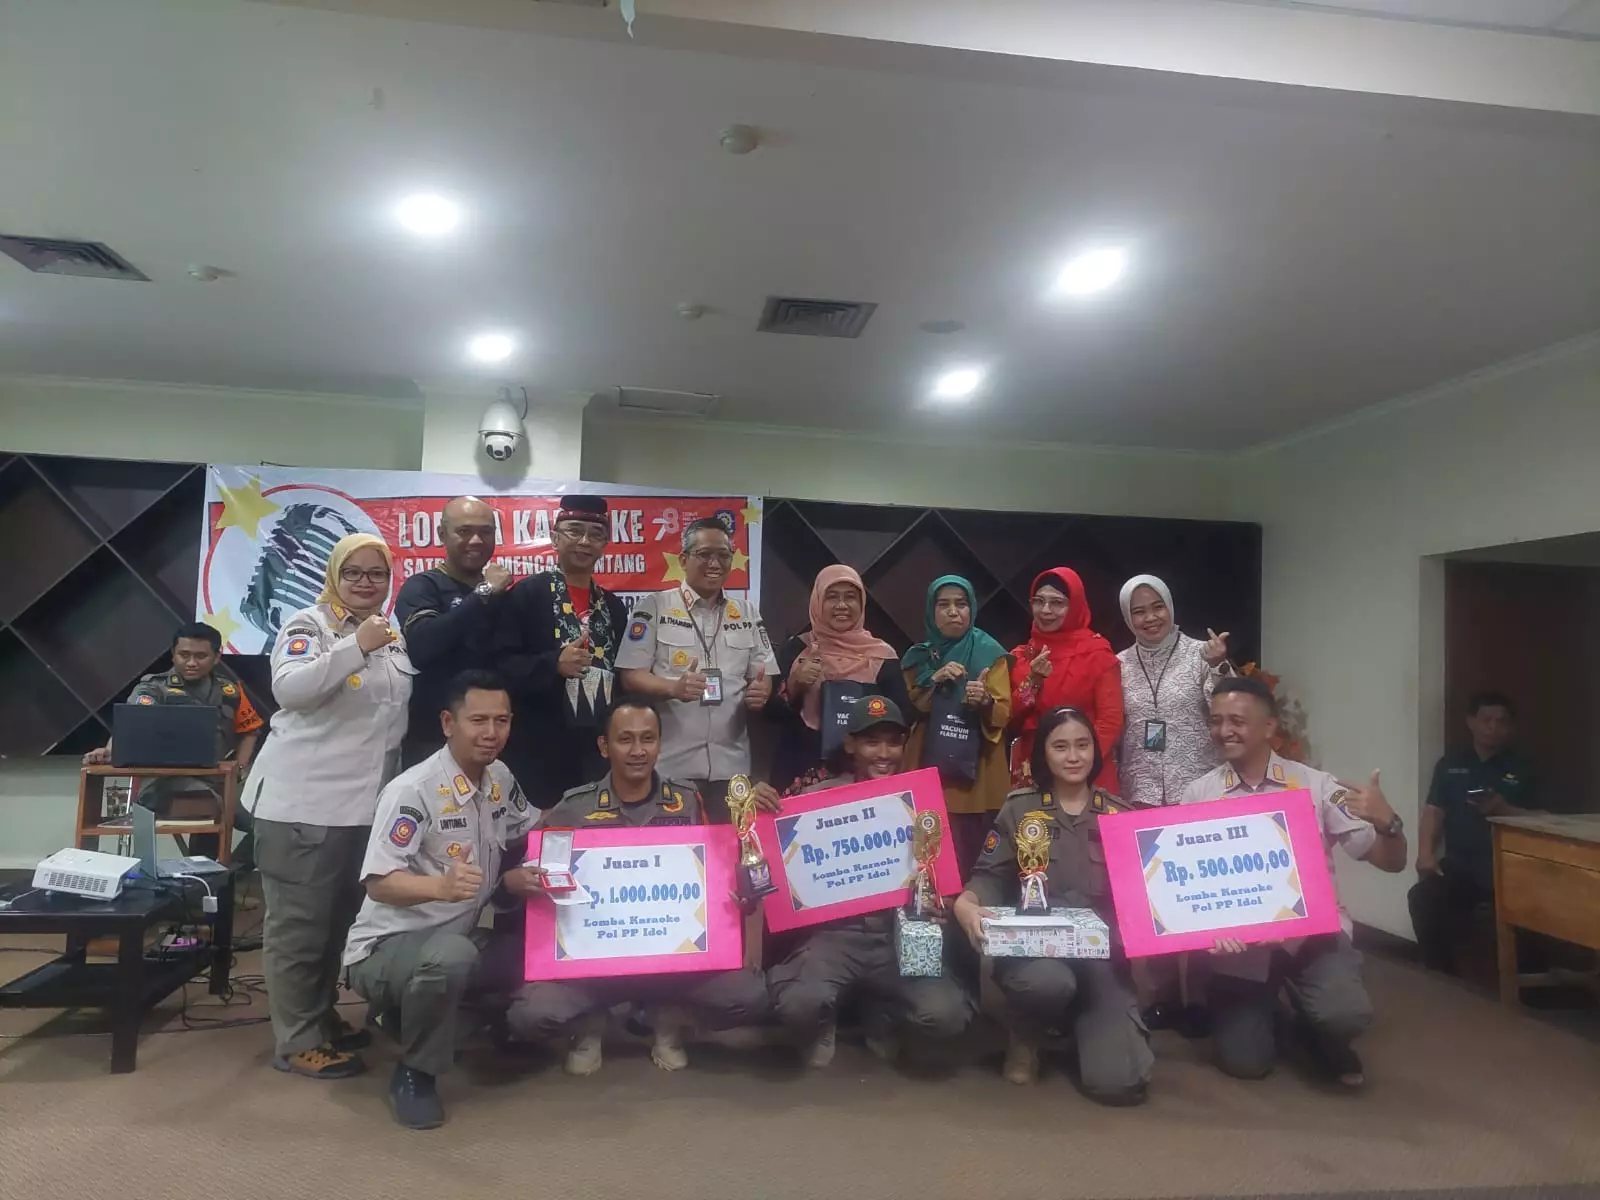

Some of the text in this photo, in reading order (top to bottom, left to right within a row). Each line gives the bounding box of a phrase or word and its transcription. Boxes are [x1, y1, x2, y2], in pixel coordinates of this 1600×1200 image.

[513, 509, 645, 545] KAKE
[593, 553, 645, 574] NTANG
[723, 623, 742, 631] POL
[939, 730, 968, 741] FLASK SET
[940, 724, 969, 735] VACUUM
[815, 806, 876, 830] Juara II
[800, 825, 914, 866] Rp. 750.000,00
[1176, 825, 1249, 847] Juara III
[602, 854, 661, 870] Juara I
[812, 856, 900, 882] Lomba Karaoke
[1162, 847, 1290, 886] Rp. 500.000,00
[826, 868, 891, 889] Pol PP Idol
[580, 882, 701, 909] p. 1.000.000,00
[1175, 883, 1273, 903] Lomba Karaoke
[1191, 895, 1263, 914] Pol PP Idol
[583, 914, 681, 928] Lomba Karaoke
[597, 927, 668, 939] Pol PP Idol
